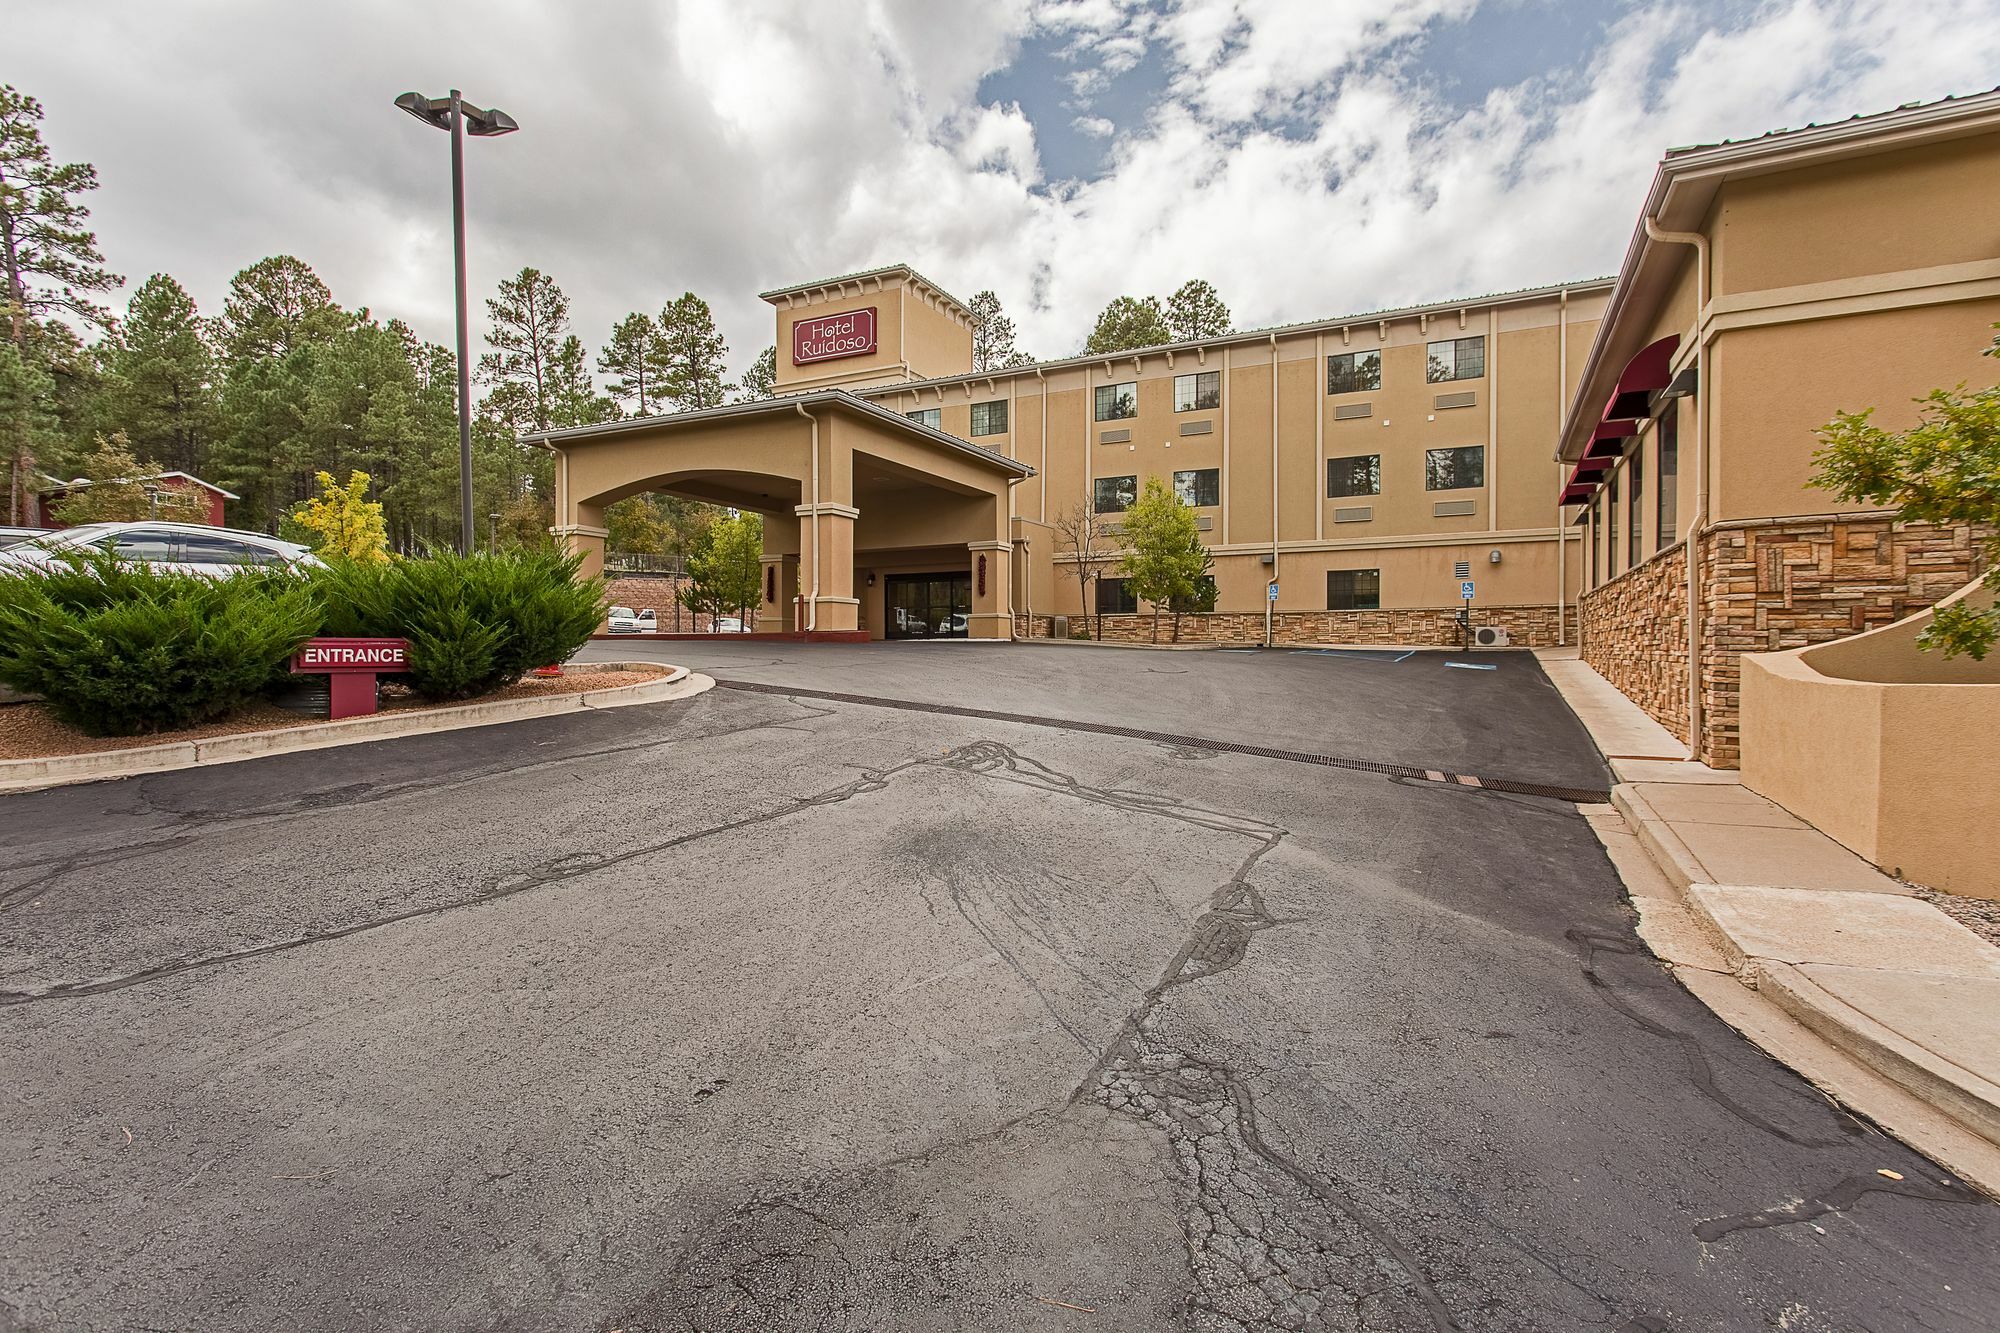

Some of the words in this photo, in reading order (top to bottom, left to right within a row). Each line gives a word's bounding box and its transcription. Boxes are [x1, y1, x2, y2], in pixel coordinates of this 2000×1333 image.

[812, 315, 854, 340] Hotel
[802, 335, 866, 357] Ruidoso
[305, 648, 404, 663] ENTRANCE
